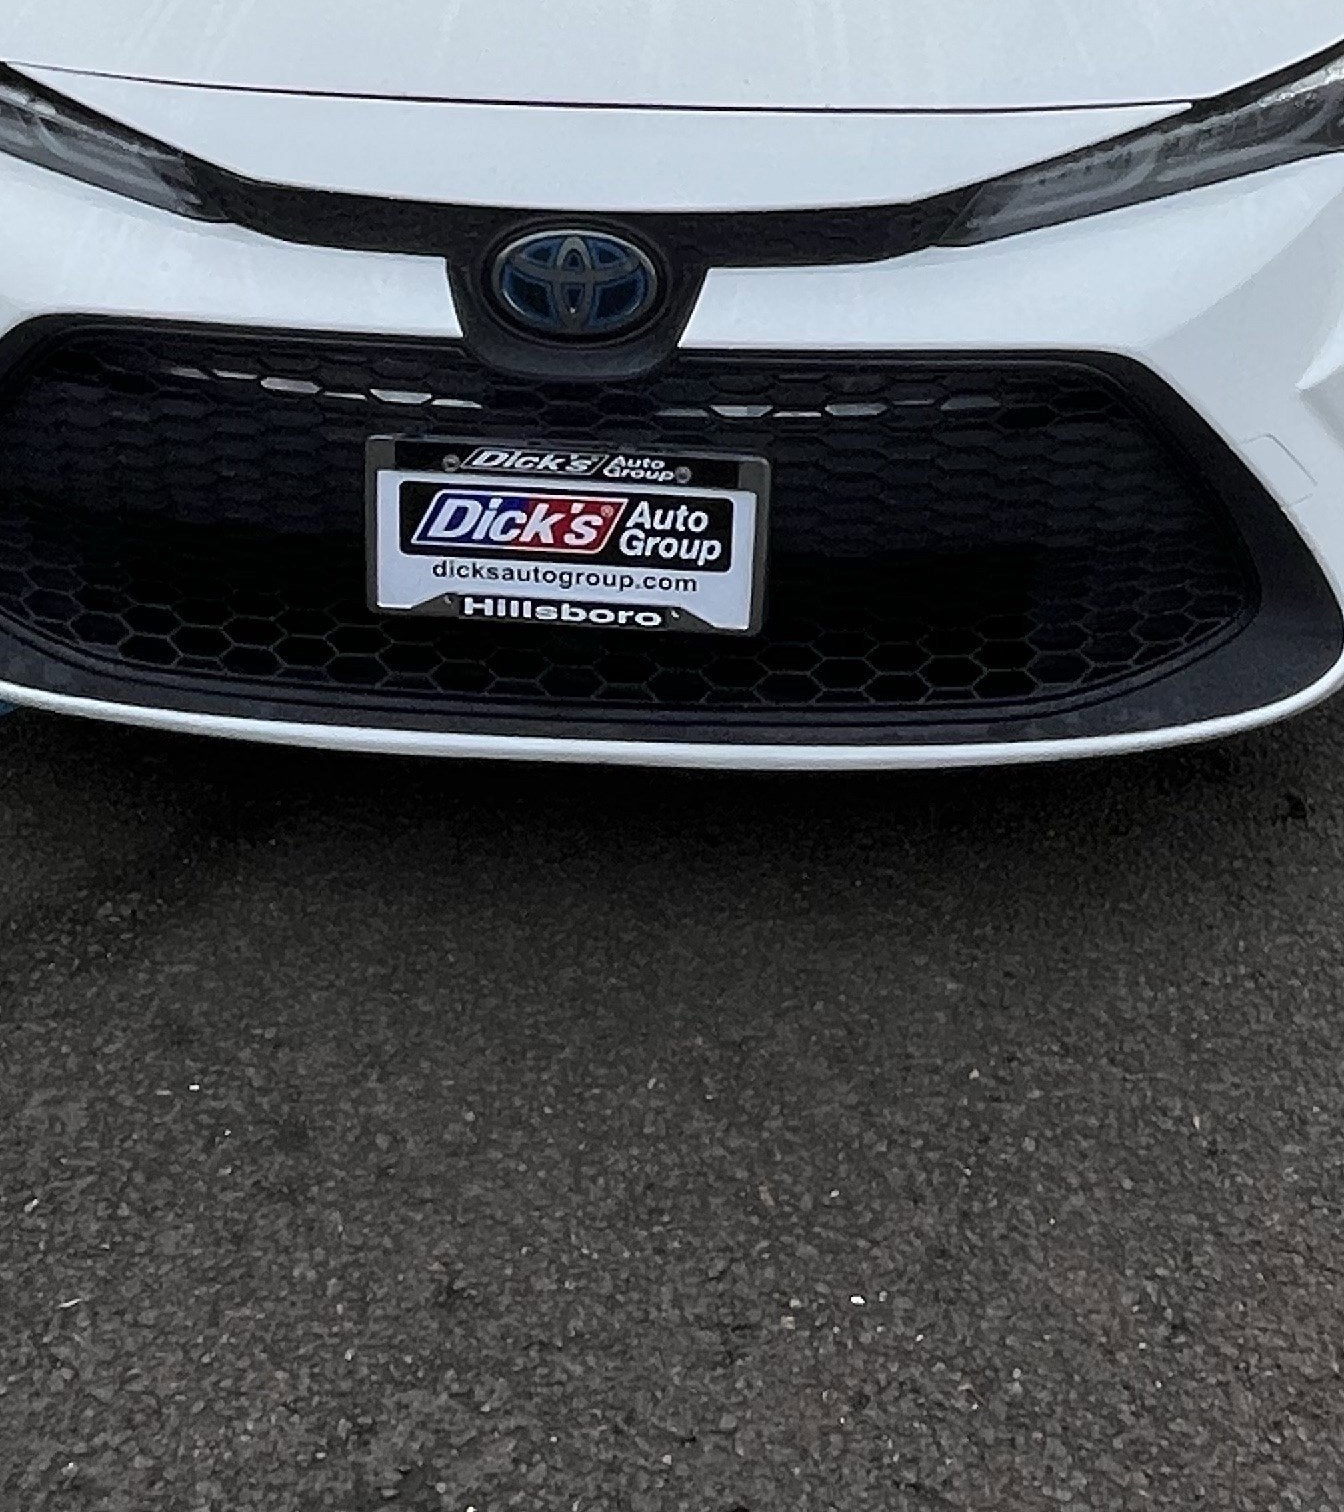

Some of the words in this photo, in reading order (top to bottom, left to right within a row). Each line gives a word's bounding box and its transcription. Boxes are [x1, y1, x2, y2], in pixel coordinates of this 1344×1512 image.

[602, 465, 675, 483] Group
[614, 455, 666, 470] Auto
[626, 501, 709, 532] Auto
[619, 528, 722, 566] Group
[432, 559, 698, 593] dicksautogroup.com
[463, 596, 663, 627] Hillsboro
